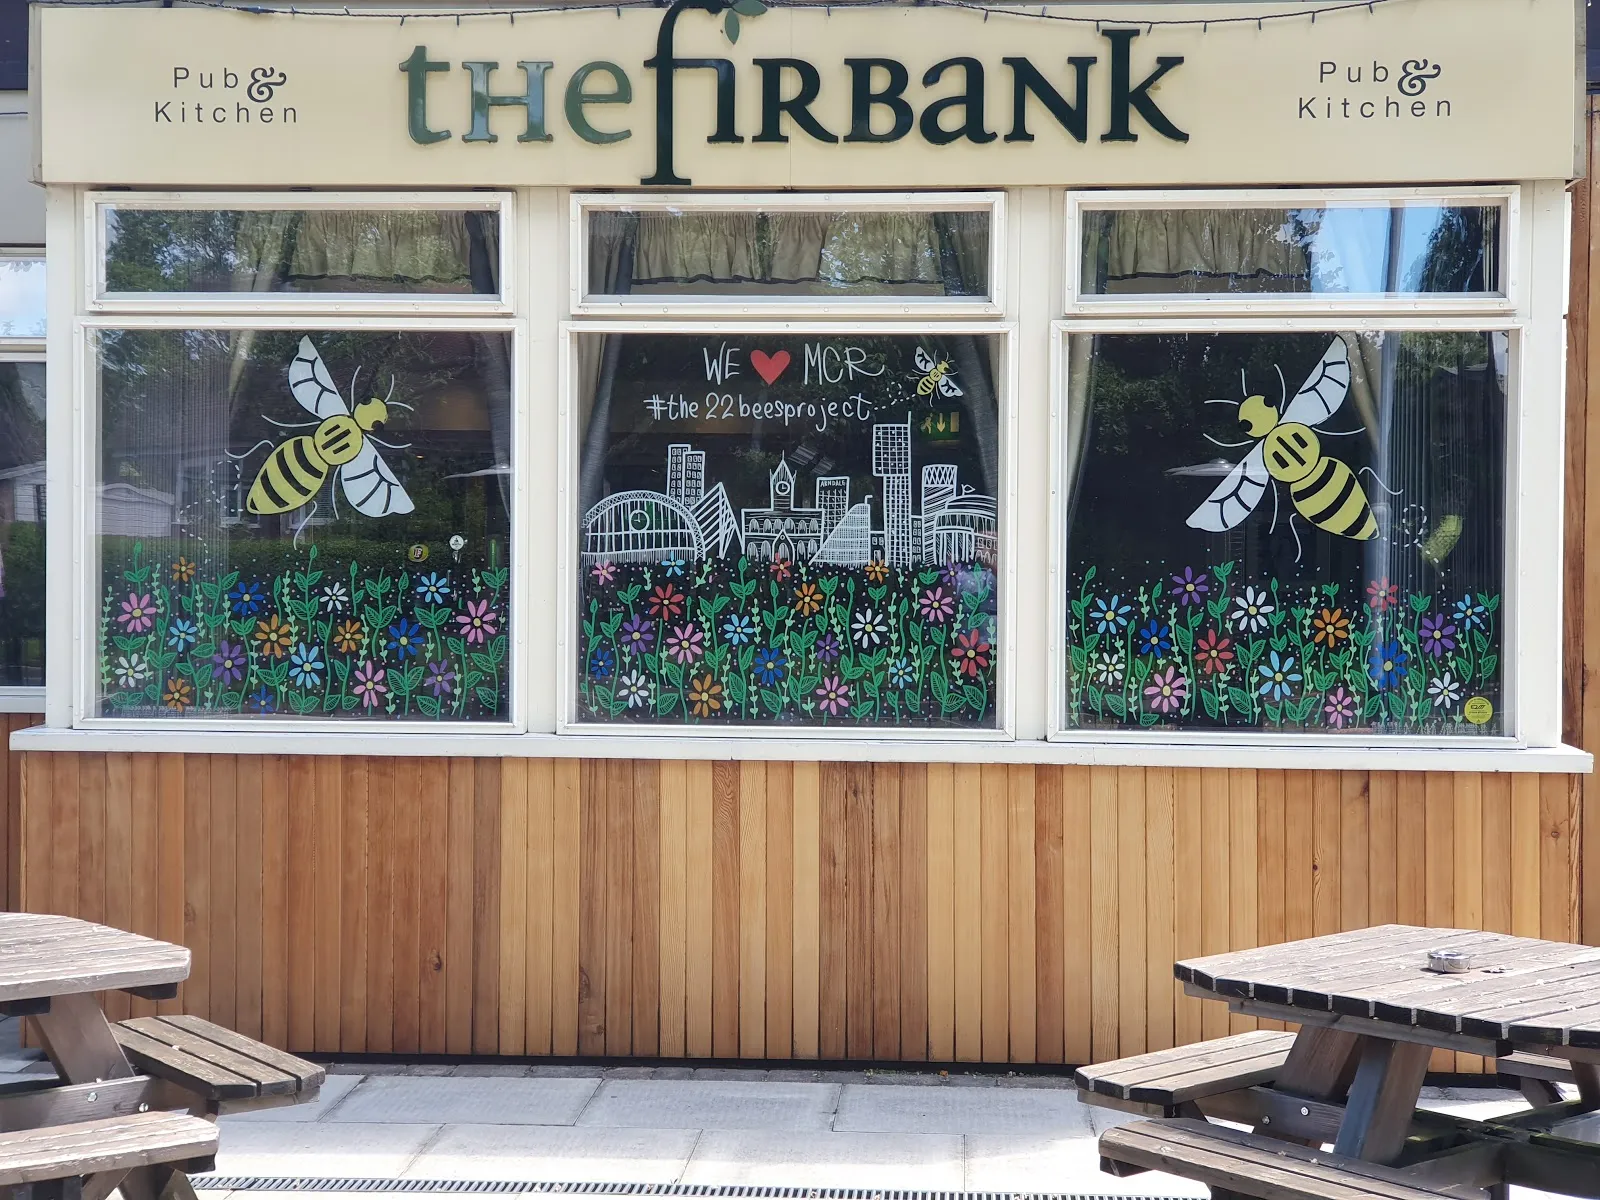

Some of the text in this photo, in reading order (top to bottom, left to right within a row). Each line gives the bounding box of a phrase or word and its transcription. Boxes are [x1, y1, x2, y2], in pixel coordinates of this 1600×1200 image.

[173, 66, 287, 103] Pub &
[1320, 59, 1441, 97] Pub &
[154, 101, 298, 124] Kitchen
[1299, 96, 1451, 119] Kitchen
[703, 341, 885, 385] WE MCR
